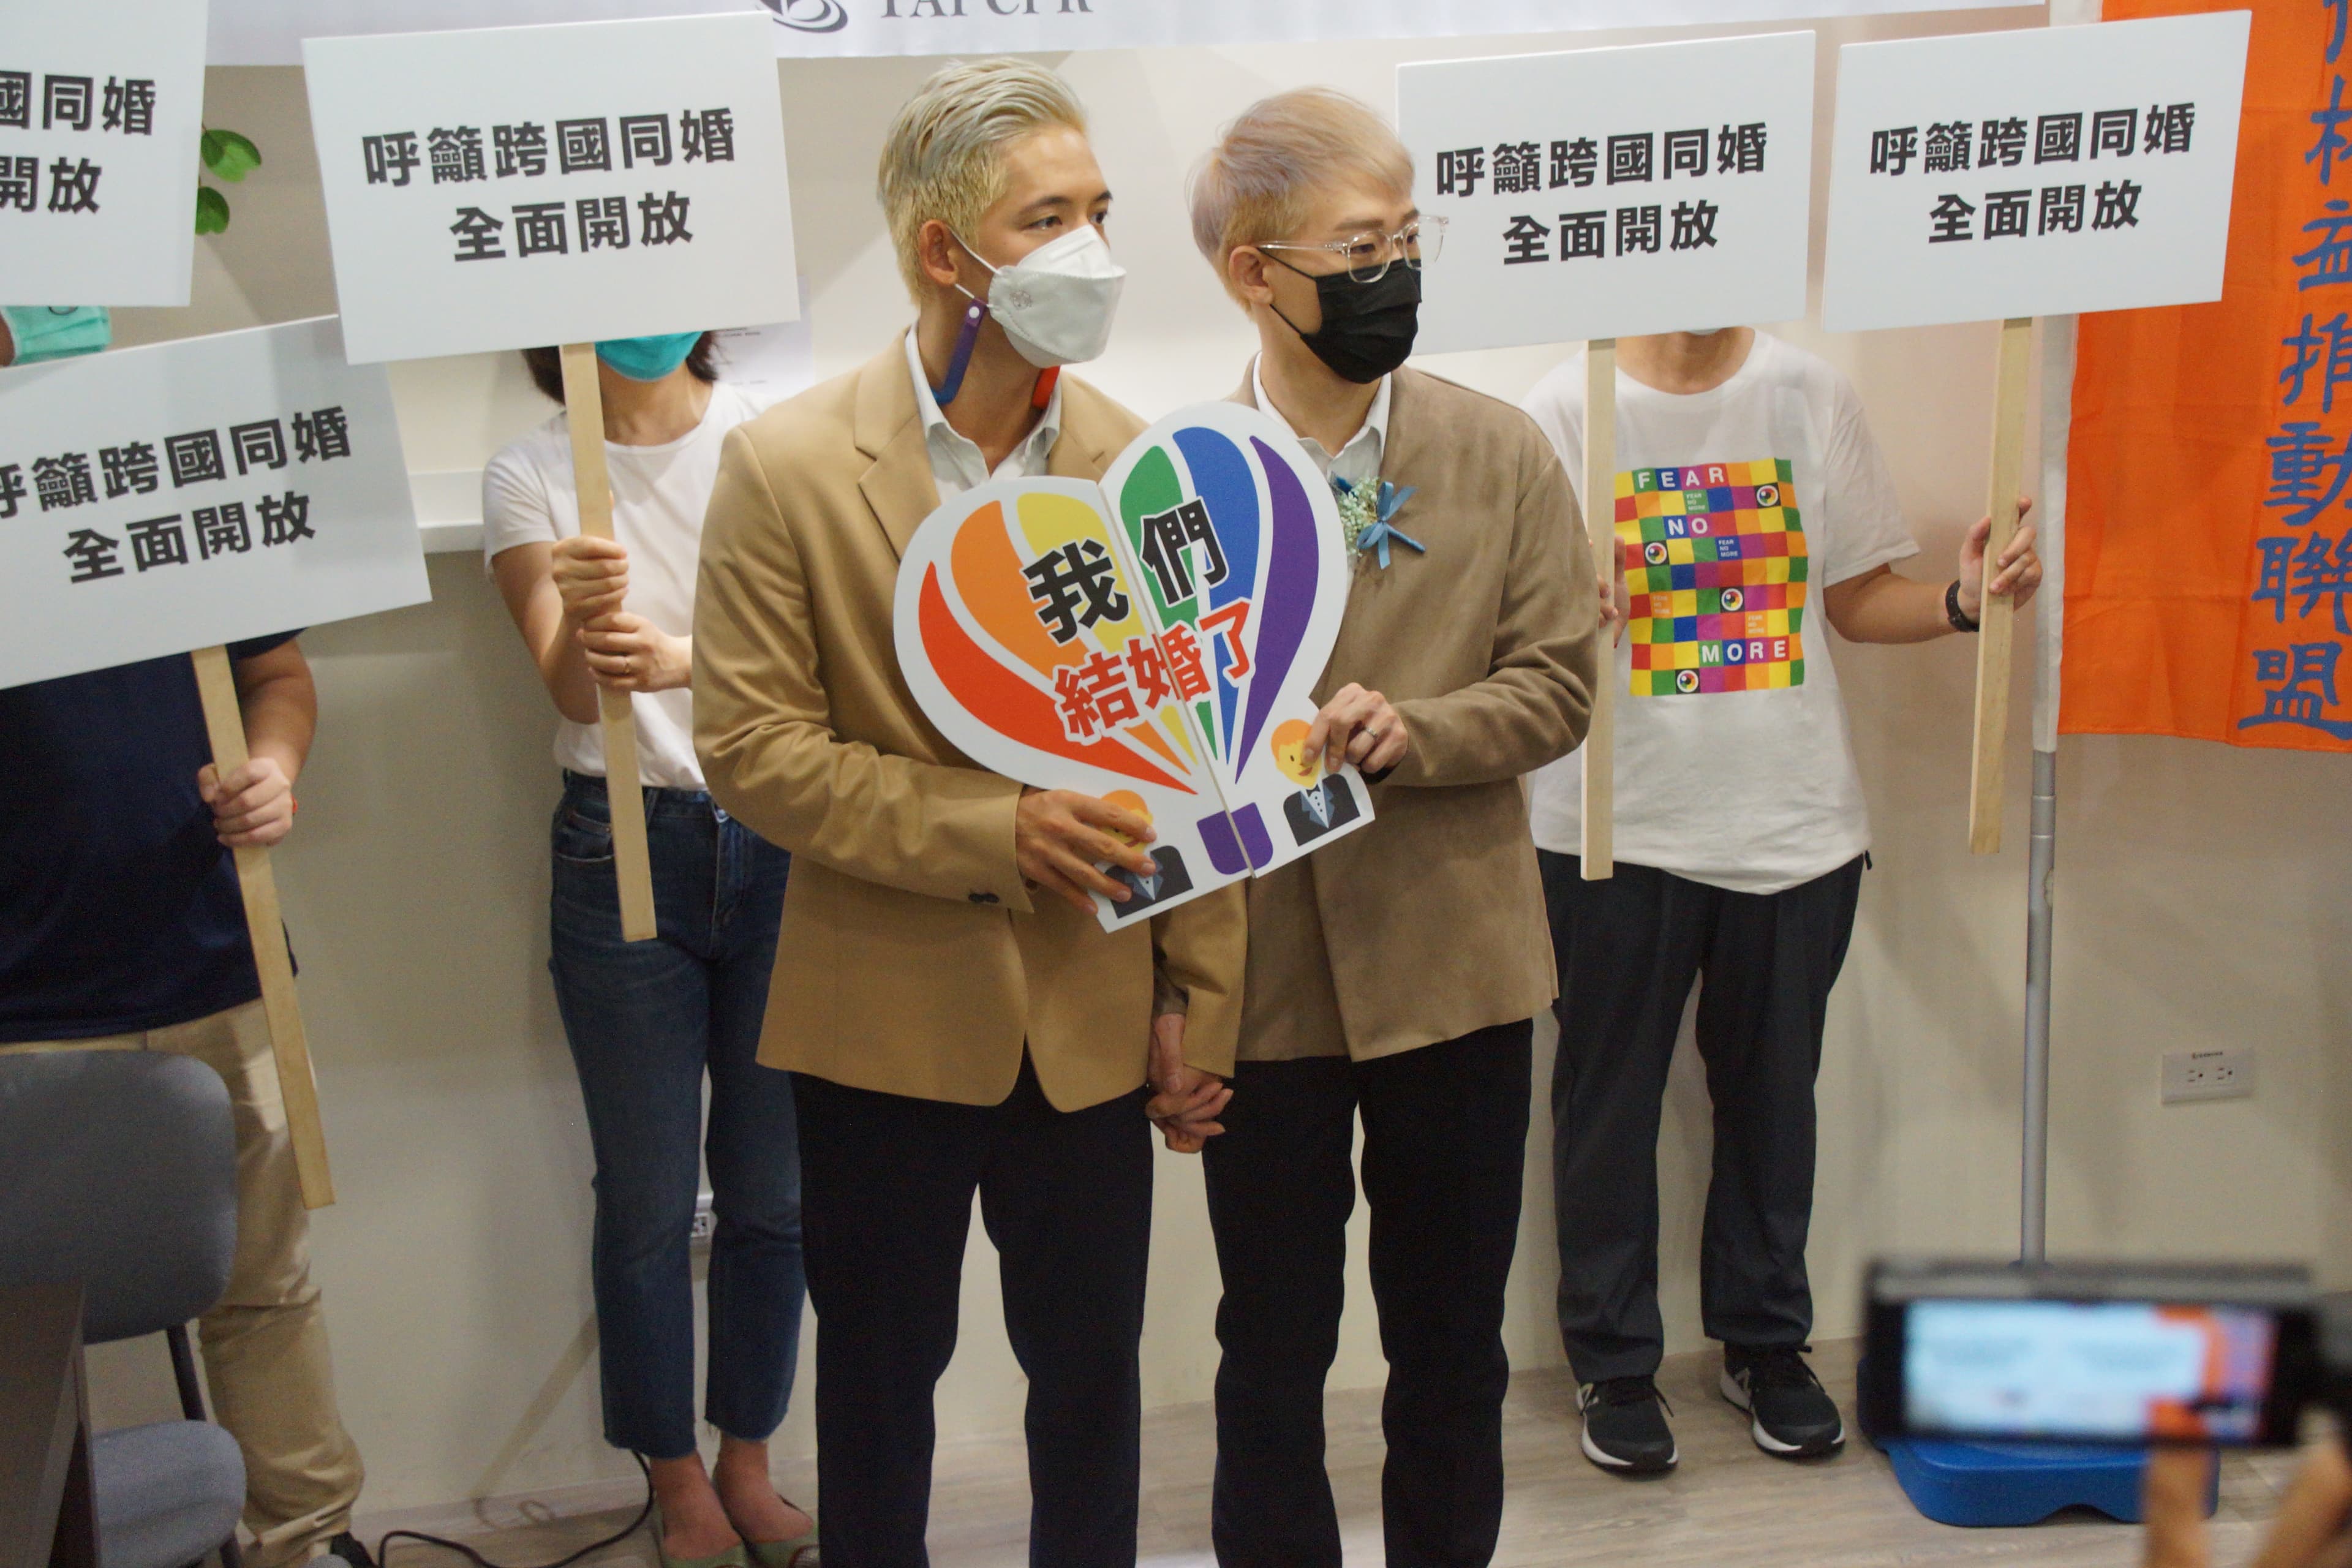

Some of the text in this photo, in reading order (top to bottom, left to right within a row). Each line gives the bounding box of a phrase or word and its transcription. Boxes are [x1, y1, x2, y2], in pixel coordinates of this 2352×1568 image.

[0, 70, 156, 135] 國同婚
[363, 108, 734, 186] 呼籲跨國同婚
[1437, 123, 1767, 197] 呼籲跨國同婚
[1871, 103, 2195, 176] 呼籲跨國同婚
[0, 156, 101, 213] 開放
[1929, 179, 2142, 243] 全面開放
[450, 191, 693, 262] 全面開放
[1503, 200, 1719, 265] 全面開放
[2238, 0, 2352, 739] 益推動聯盟
[1638, 467, 1724, 489] FEAR
[63, 491, 315, 583] 全面開放
[1668, 518, 1708, 535] NO
[1023, 499, 1227, 644] 我們
[1054, 601, 1250, 737] 結婚了
[1702, 640, 1787, 663] MORE
